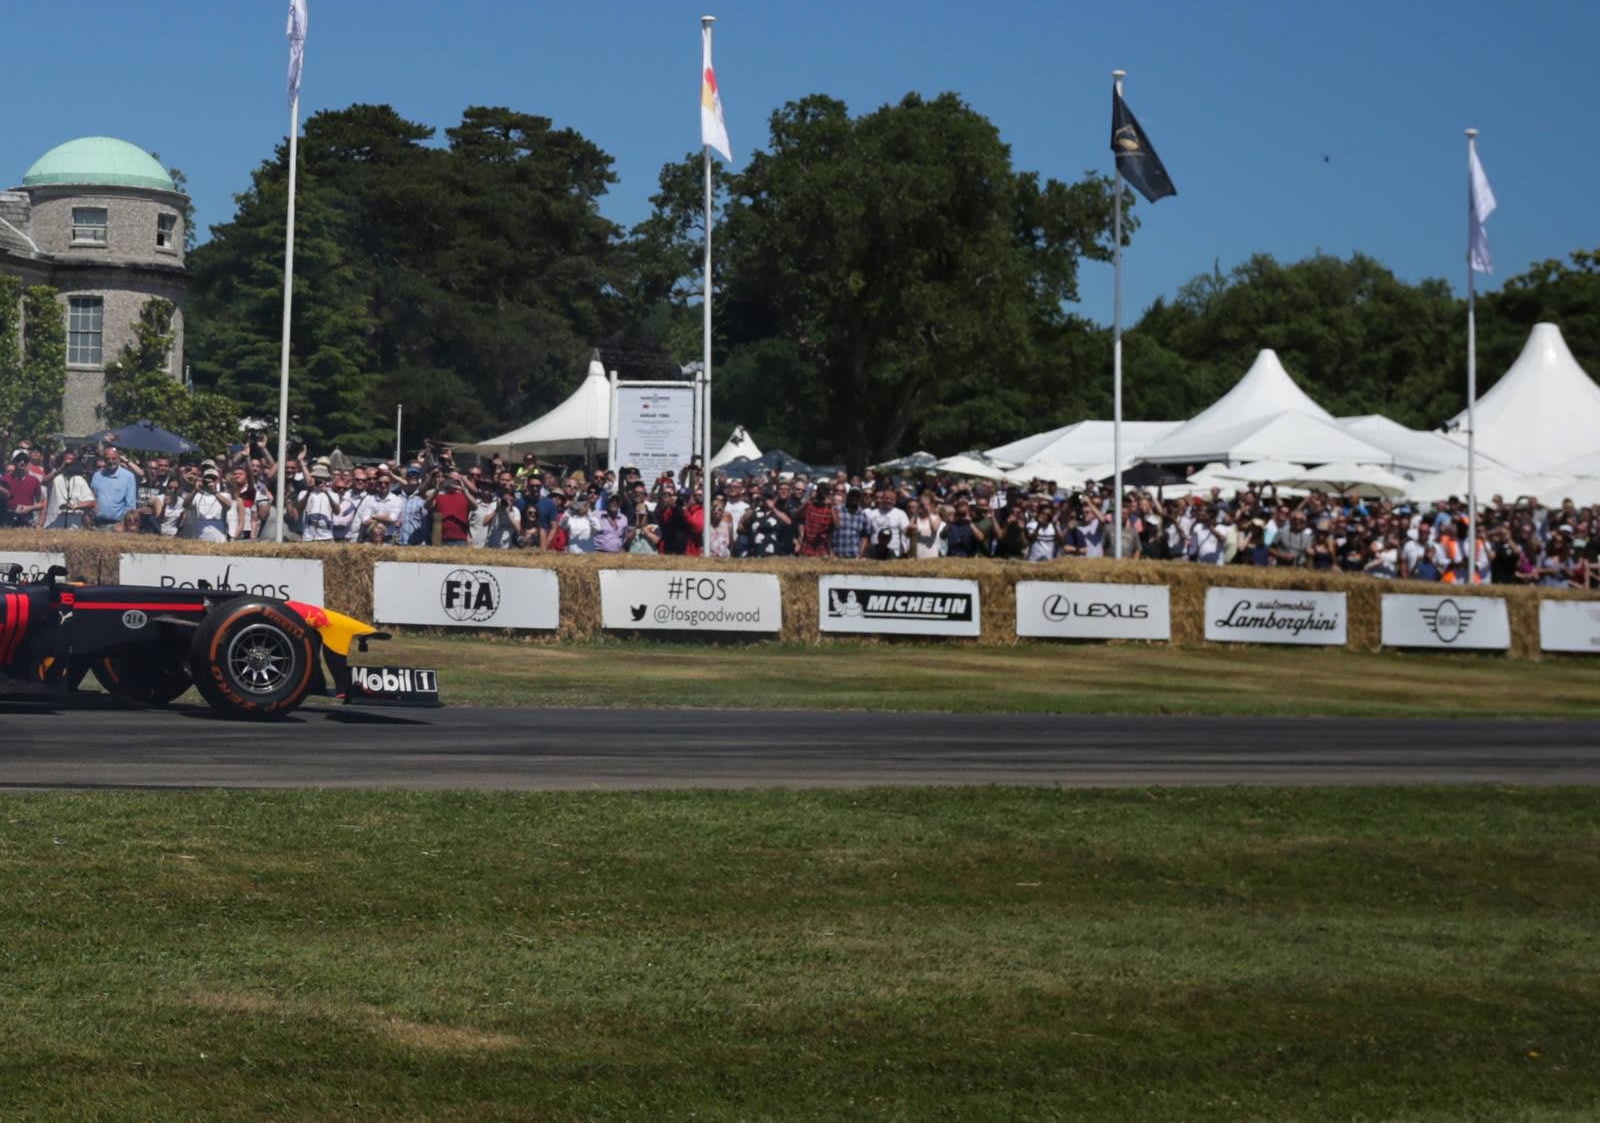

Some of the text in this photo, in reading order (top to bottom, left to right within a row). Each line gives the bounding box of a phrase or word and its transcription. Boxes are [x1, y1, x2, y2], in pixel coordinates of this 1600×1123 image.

[445, 580, 494, 610] FiA
[668, 577, 727, 601] #FOS
[653, 605, 760, 626] @fosgoodwood
[866, 595, 968, 614] MICHELIN
[1073, 602, 1149, 619] LEXUS
[1215, 600, 1339, 636] Lamborghini
[351, 666, 412, 692] Mobil
